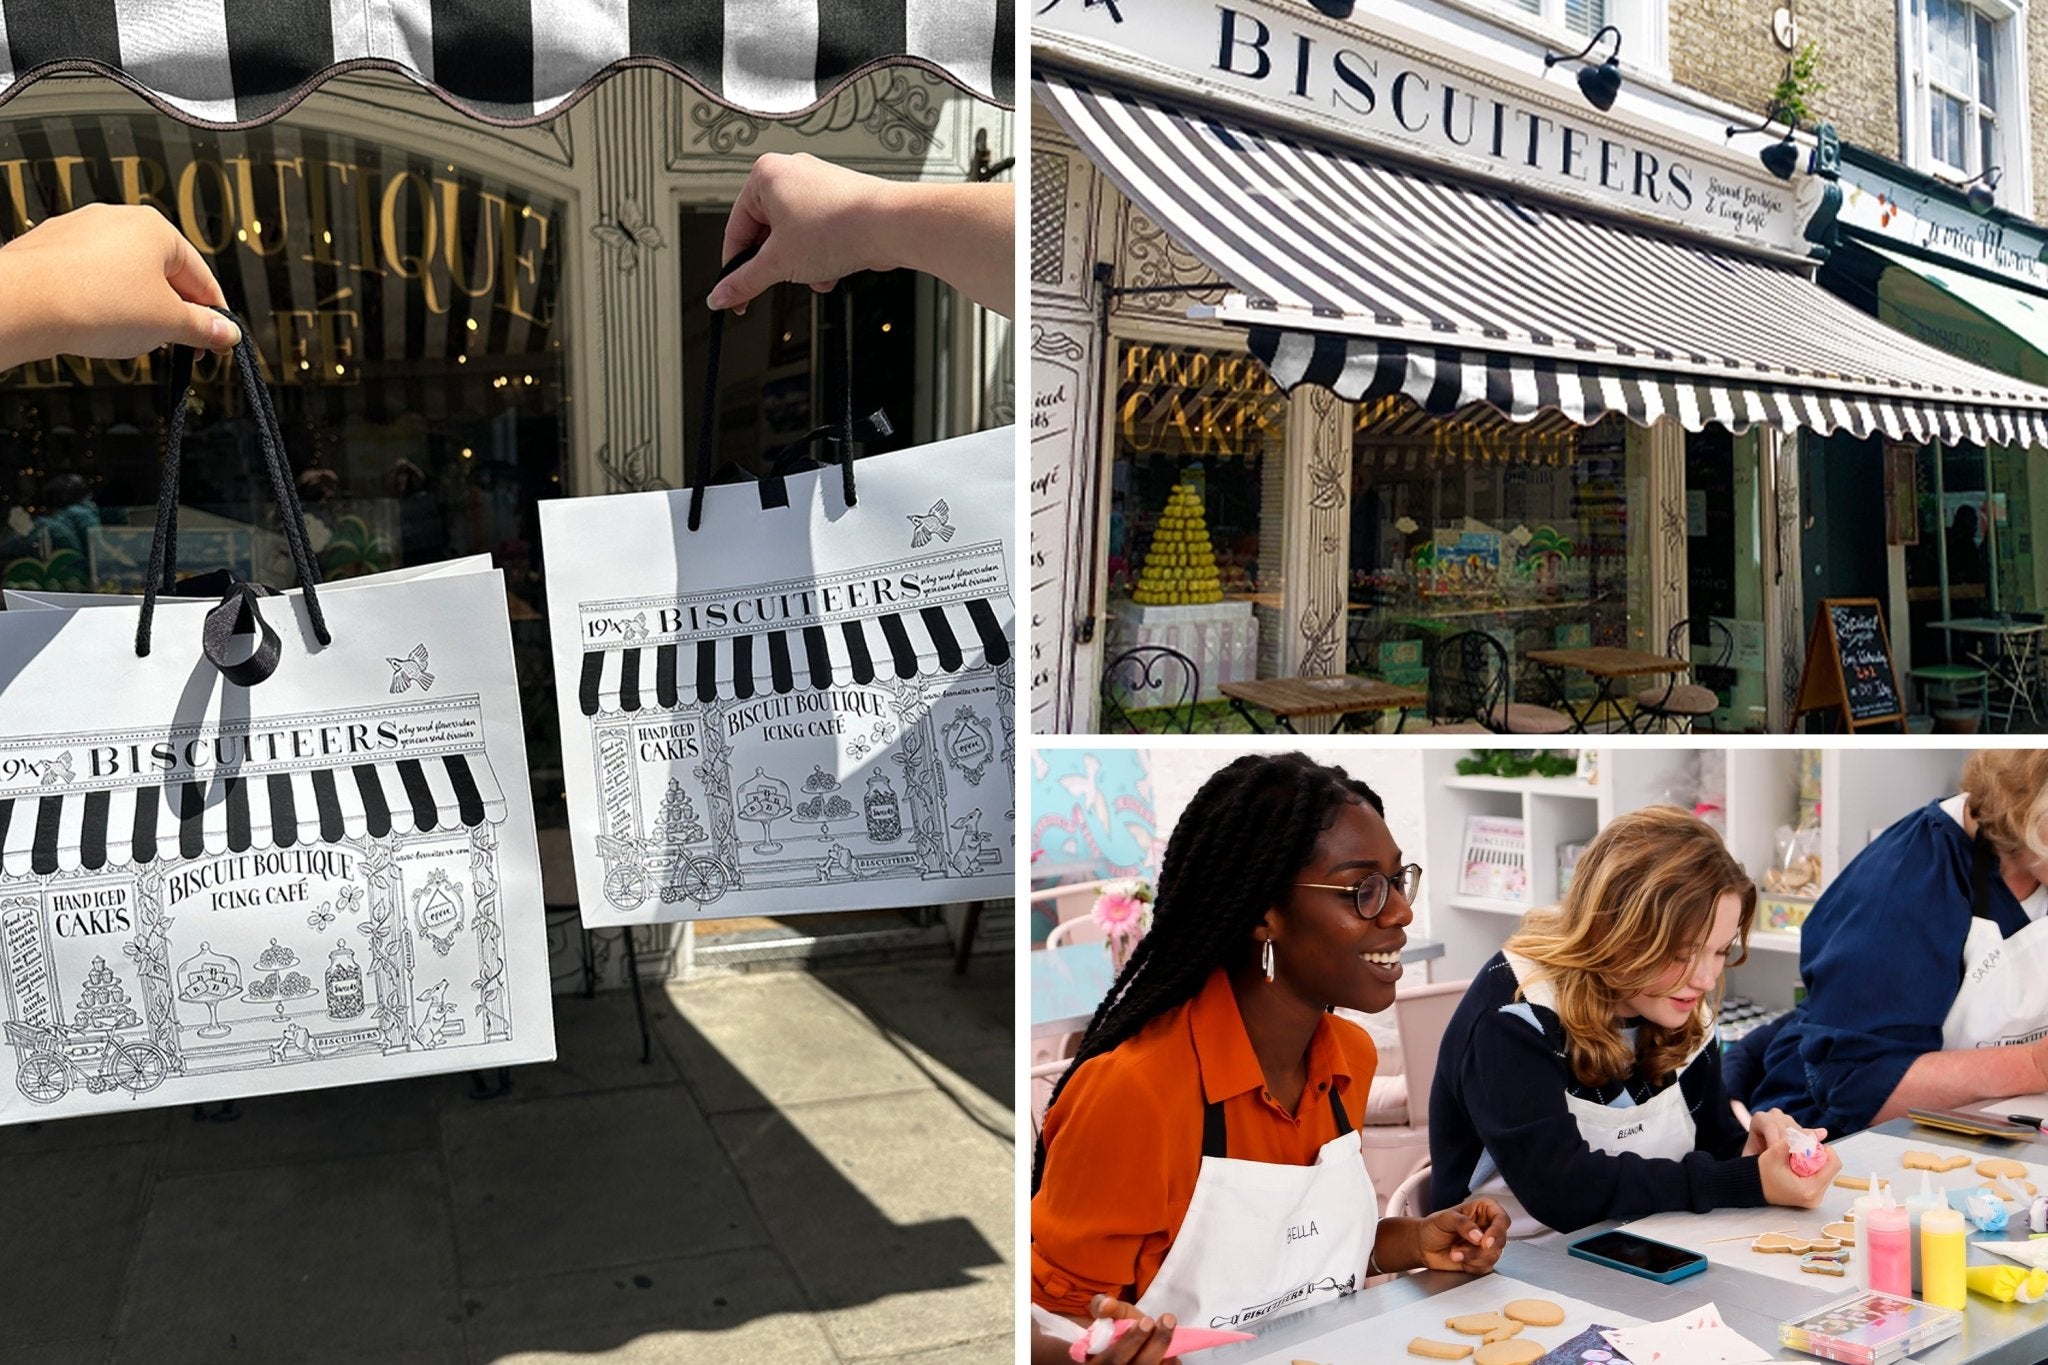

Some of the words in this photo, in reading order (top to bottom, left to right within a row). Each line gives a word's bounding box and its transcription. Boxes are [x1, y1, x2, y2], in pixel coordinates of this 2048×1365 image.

[1210, 4, 1693, 212] BISCUITEERS
[110, 155, 556, 328] BOUTIQUE
[1126, 346, 1209, 387] HAND
[656, 573, 922, 634] BISCUITEERS
[727, 697, 794, 738] BISCUIT
[797, 690, 888, 719] BOUTIQUE
[763, 723, 805, 742] ICING
[808, 714, 847, 736] CAFÉ
[638, 726, 669, 742] HAND
[669, 722, 695, 738] ICED
[0, 758, 40, 781] 94
[88, 720, 399, 778] BISCUITEERS
[640, 737, 700, 764] CAKES
[860, 855, 917, 867] BISCUITEERS
[168, 856, 250, 907] BISCUIT
[253, 849, 356, 882] BOUTIQUE
[211, 888, 261, 912] ICING
[265, 877, 310, 904] CAFÉ
[53, 893, 91, 912] HAND
[91, 888, 126, 909] ICED
[55, 907, 132, 939] CAKES
[318, 1031, 379, 1047] BISCUITEERS
[1287, 1220, 1319, 1244] BELLA
[1243, 1289, 1304, 1322] BISCUITEERS
